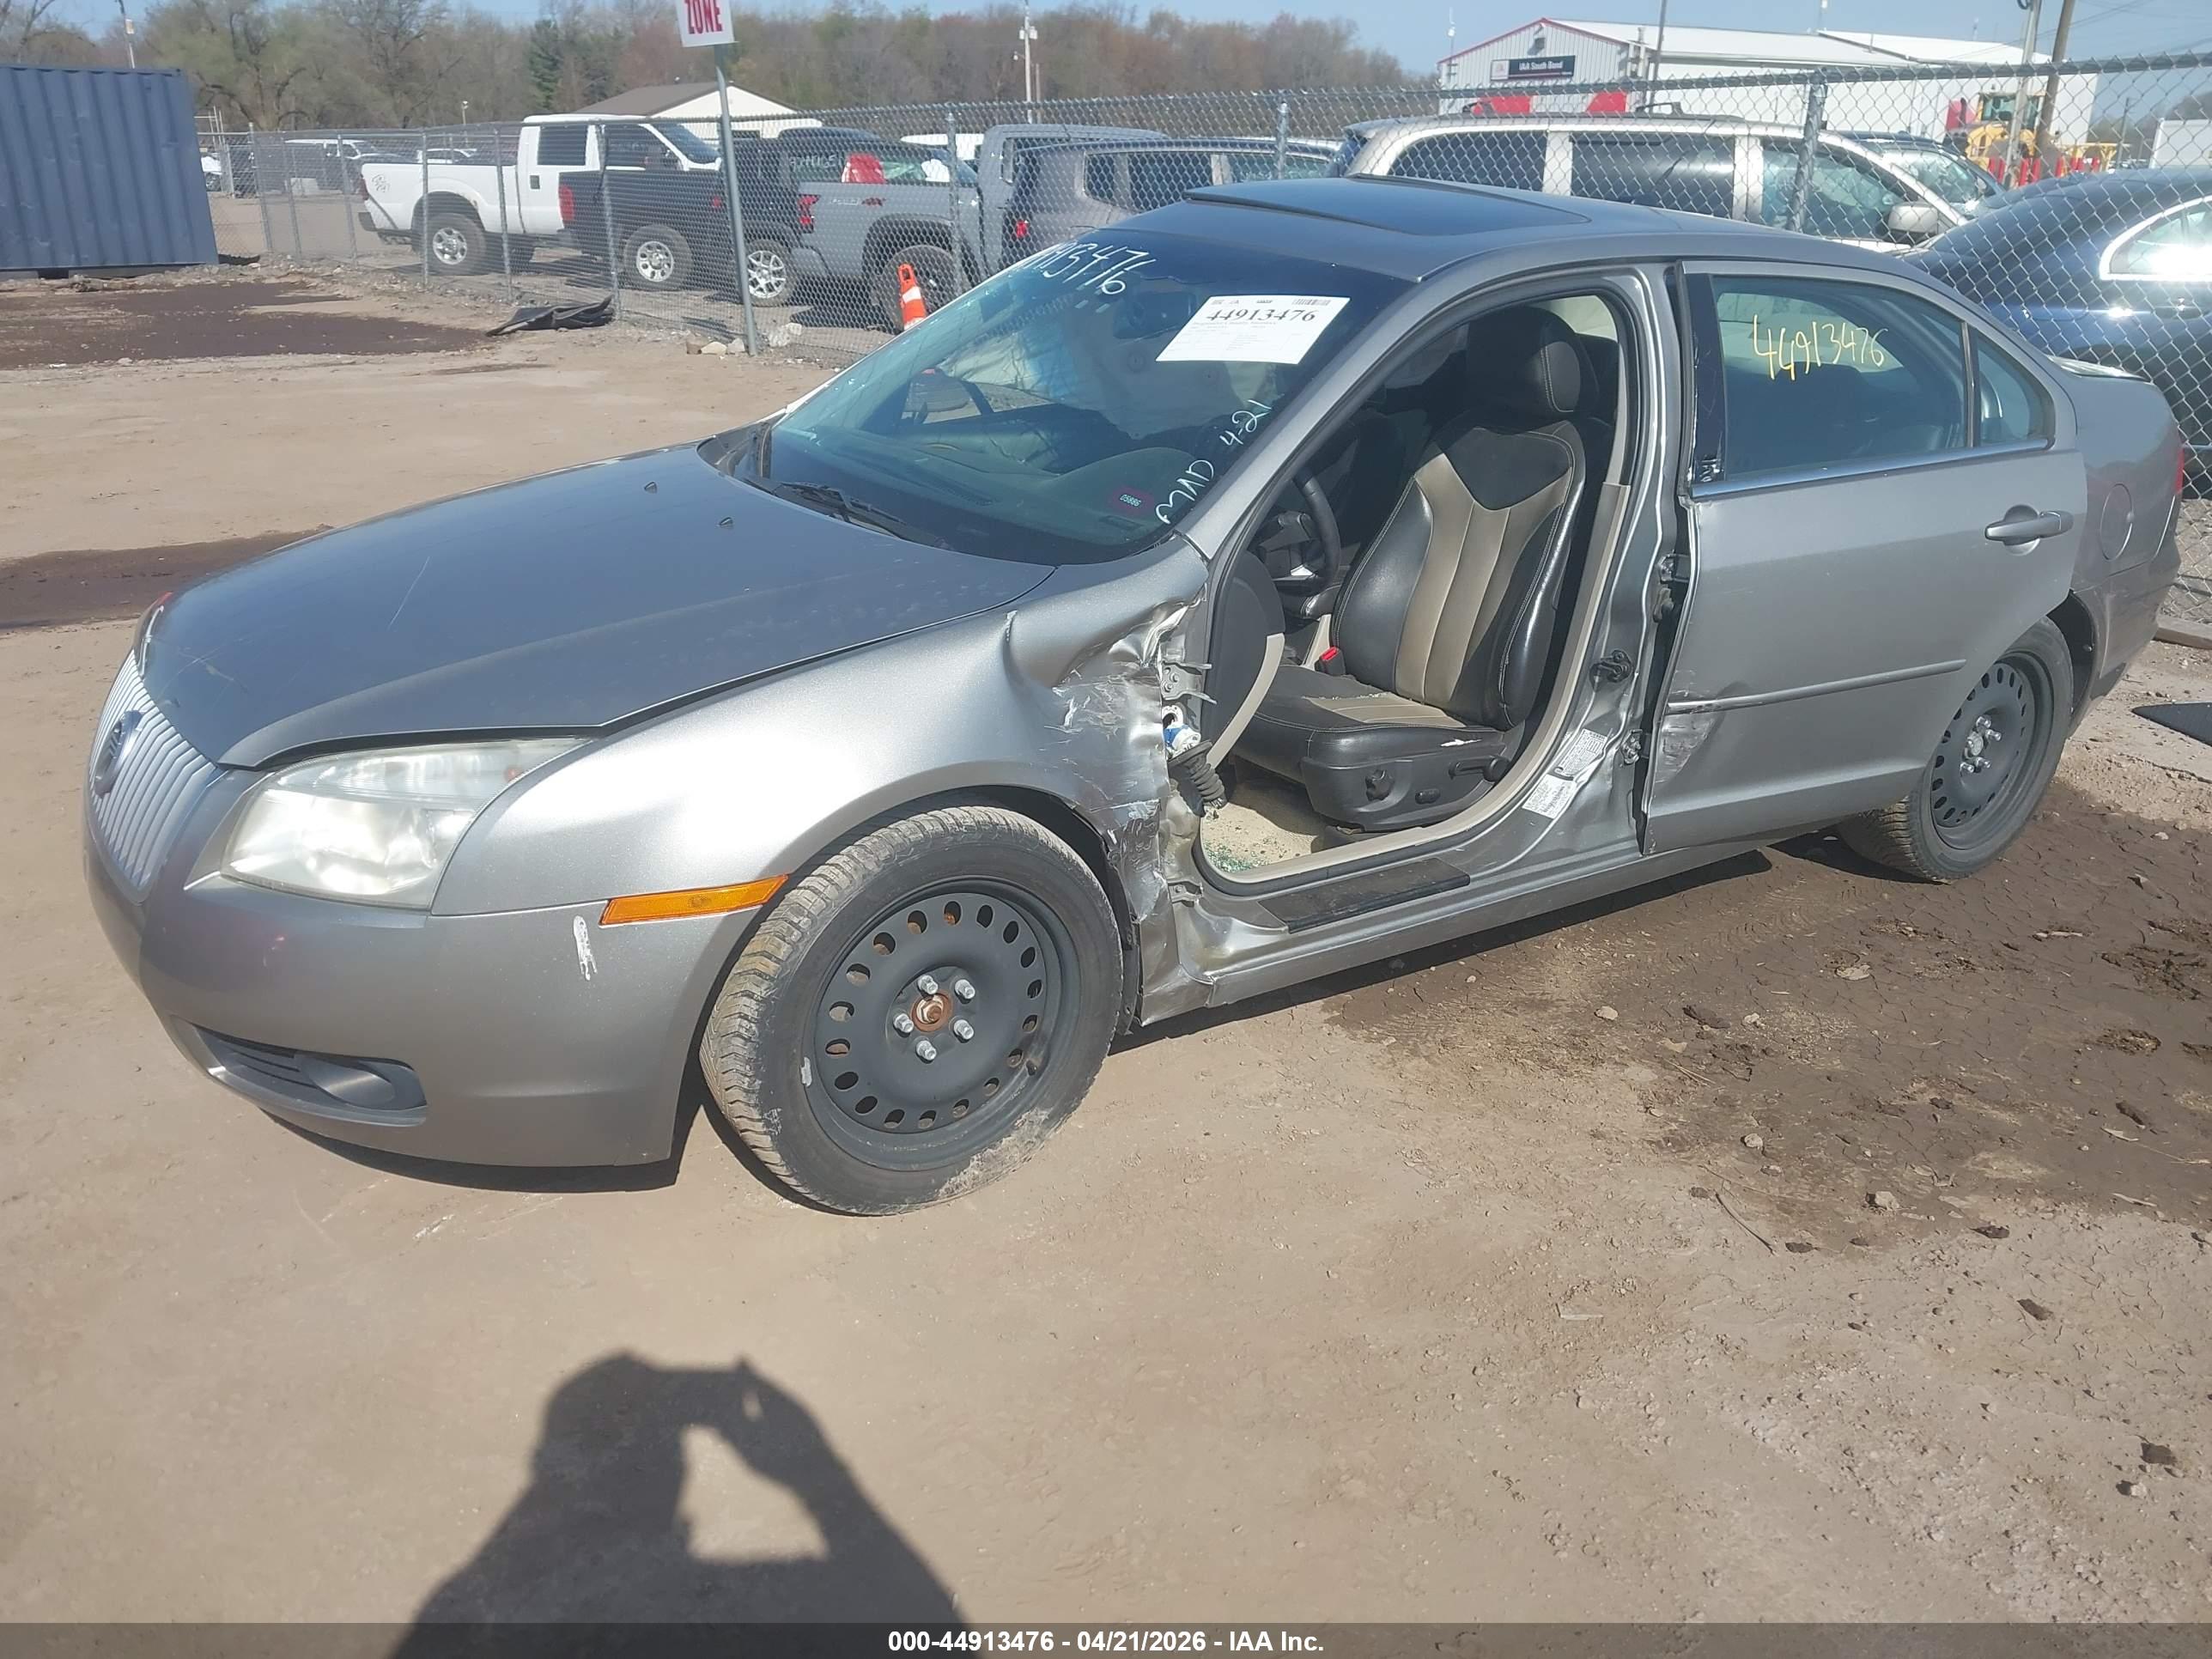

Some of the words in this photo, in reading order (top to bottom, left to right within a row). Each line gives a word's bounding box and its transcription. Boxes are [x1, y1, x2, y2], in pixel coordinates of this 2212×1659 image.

[684, 0, 723, 34] ZONE
[1531, 61, 1547, 70] South
[1548, 60, 1563, 69] Bend
[1206, 308, 1318, 322] 44913476
[1753, 313, 1889, 380] 44913476
[1219, 399, 1272, 446] 4-21
